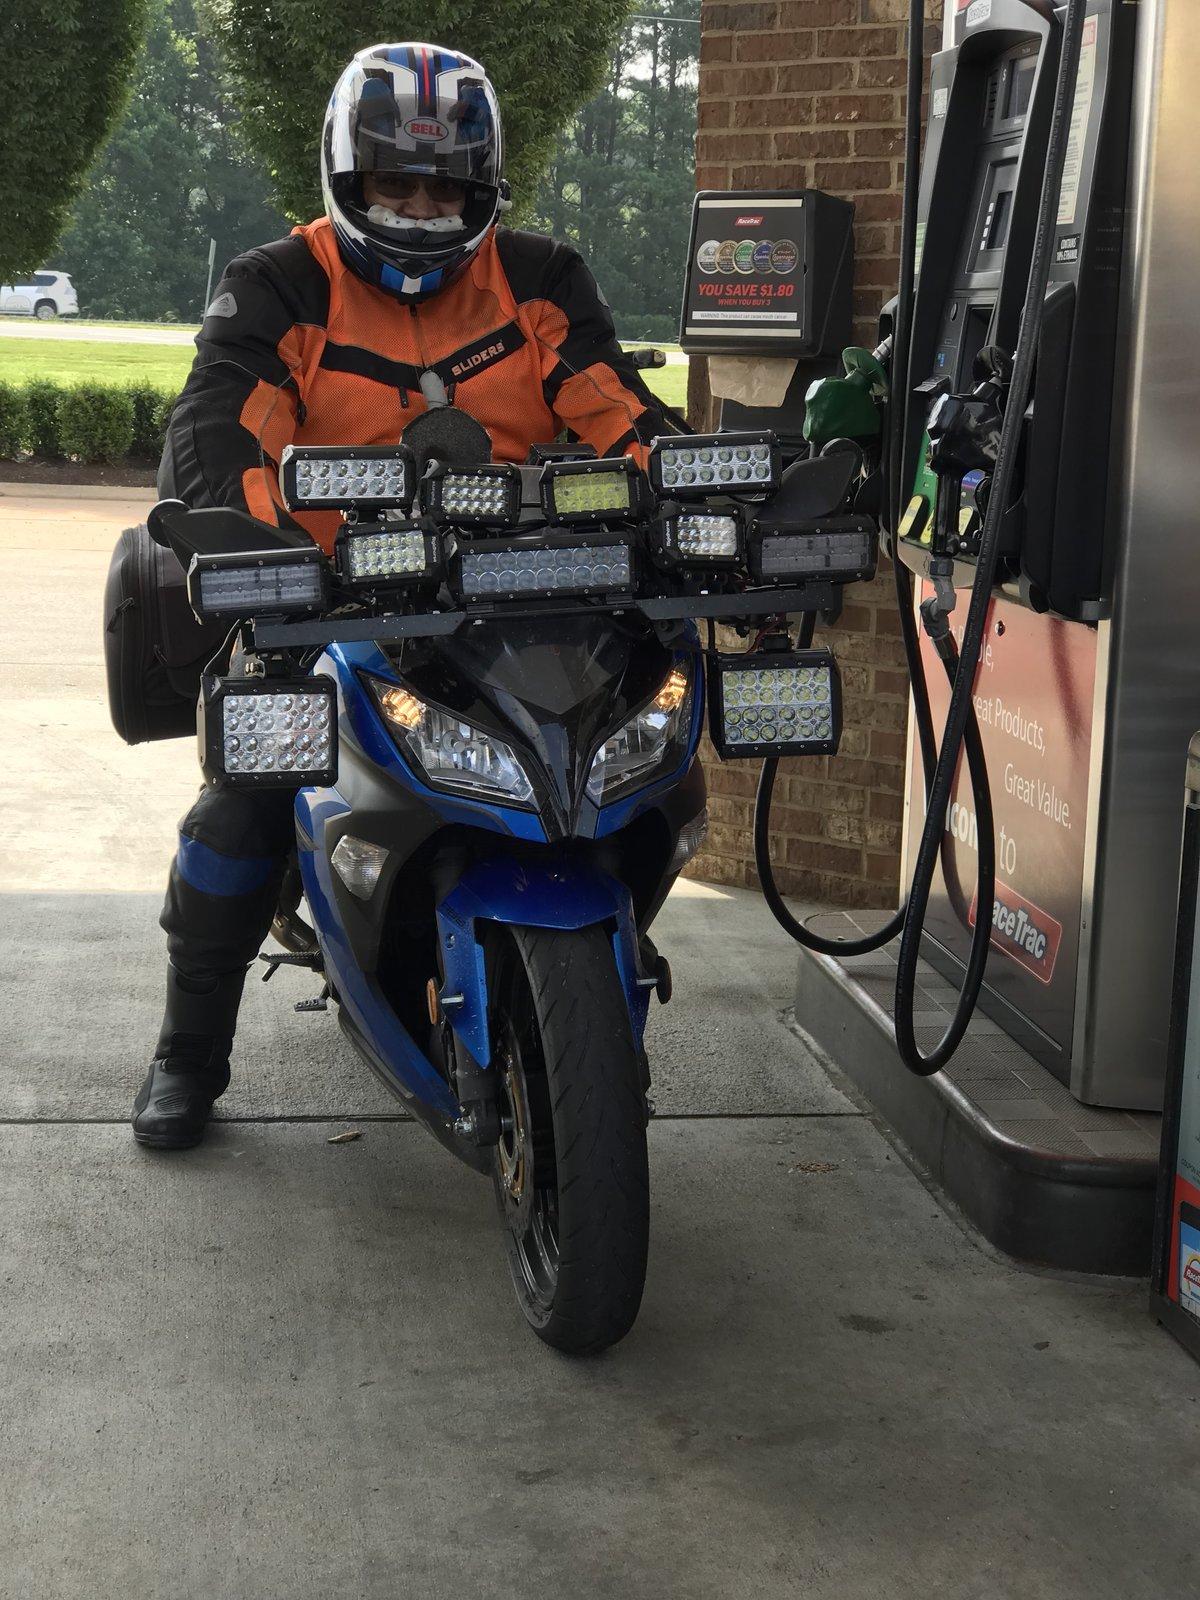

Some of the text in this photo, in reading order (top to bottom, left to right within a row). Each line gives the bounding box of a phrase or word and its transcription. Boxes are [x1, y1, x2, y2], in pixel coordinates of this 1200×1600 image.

[411, 123, 443, 137] BELL
[699, 283, 794, 297] YOU SAVE $1.80
[451, 342, 505, 376] SLIDERS
[973, 695, 1046, 757] reat Products,
[1004, 763, 1072, 830] Great Value.
[999, 825, 1016, 876] to
[992, 900, 1046, 959] aceTrac
